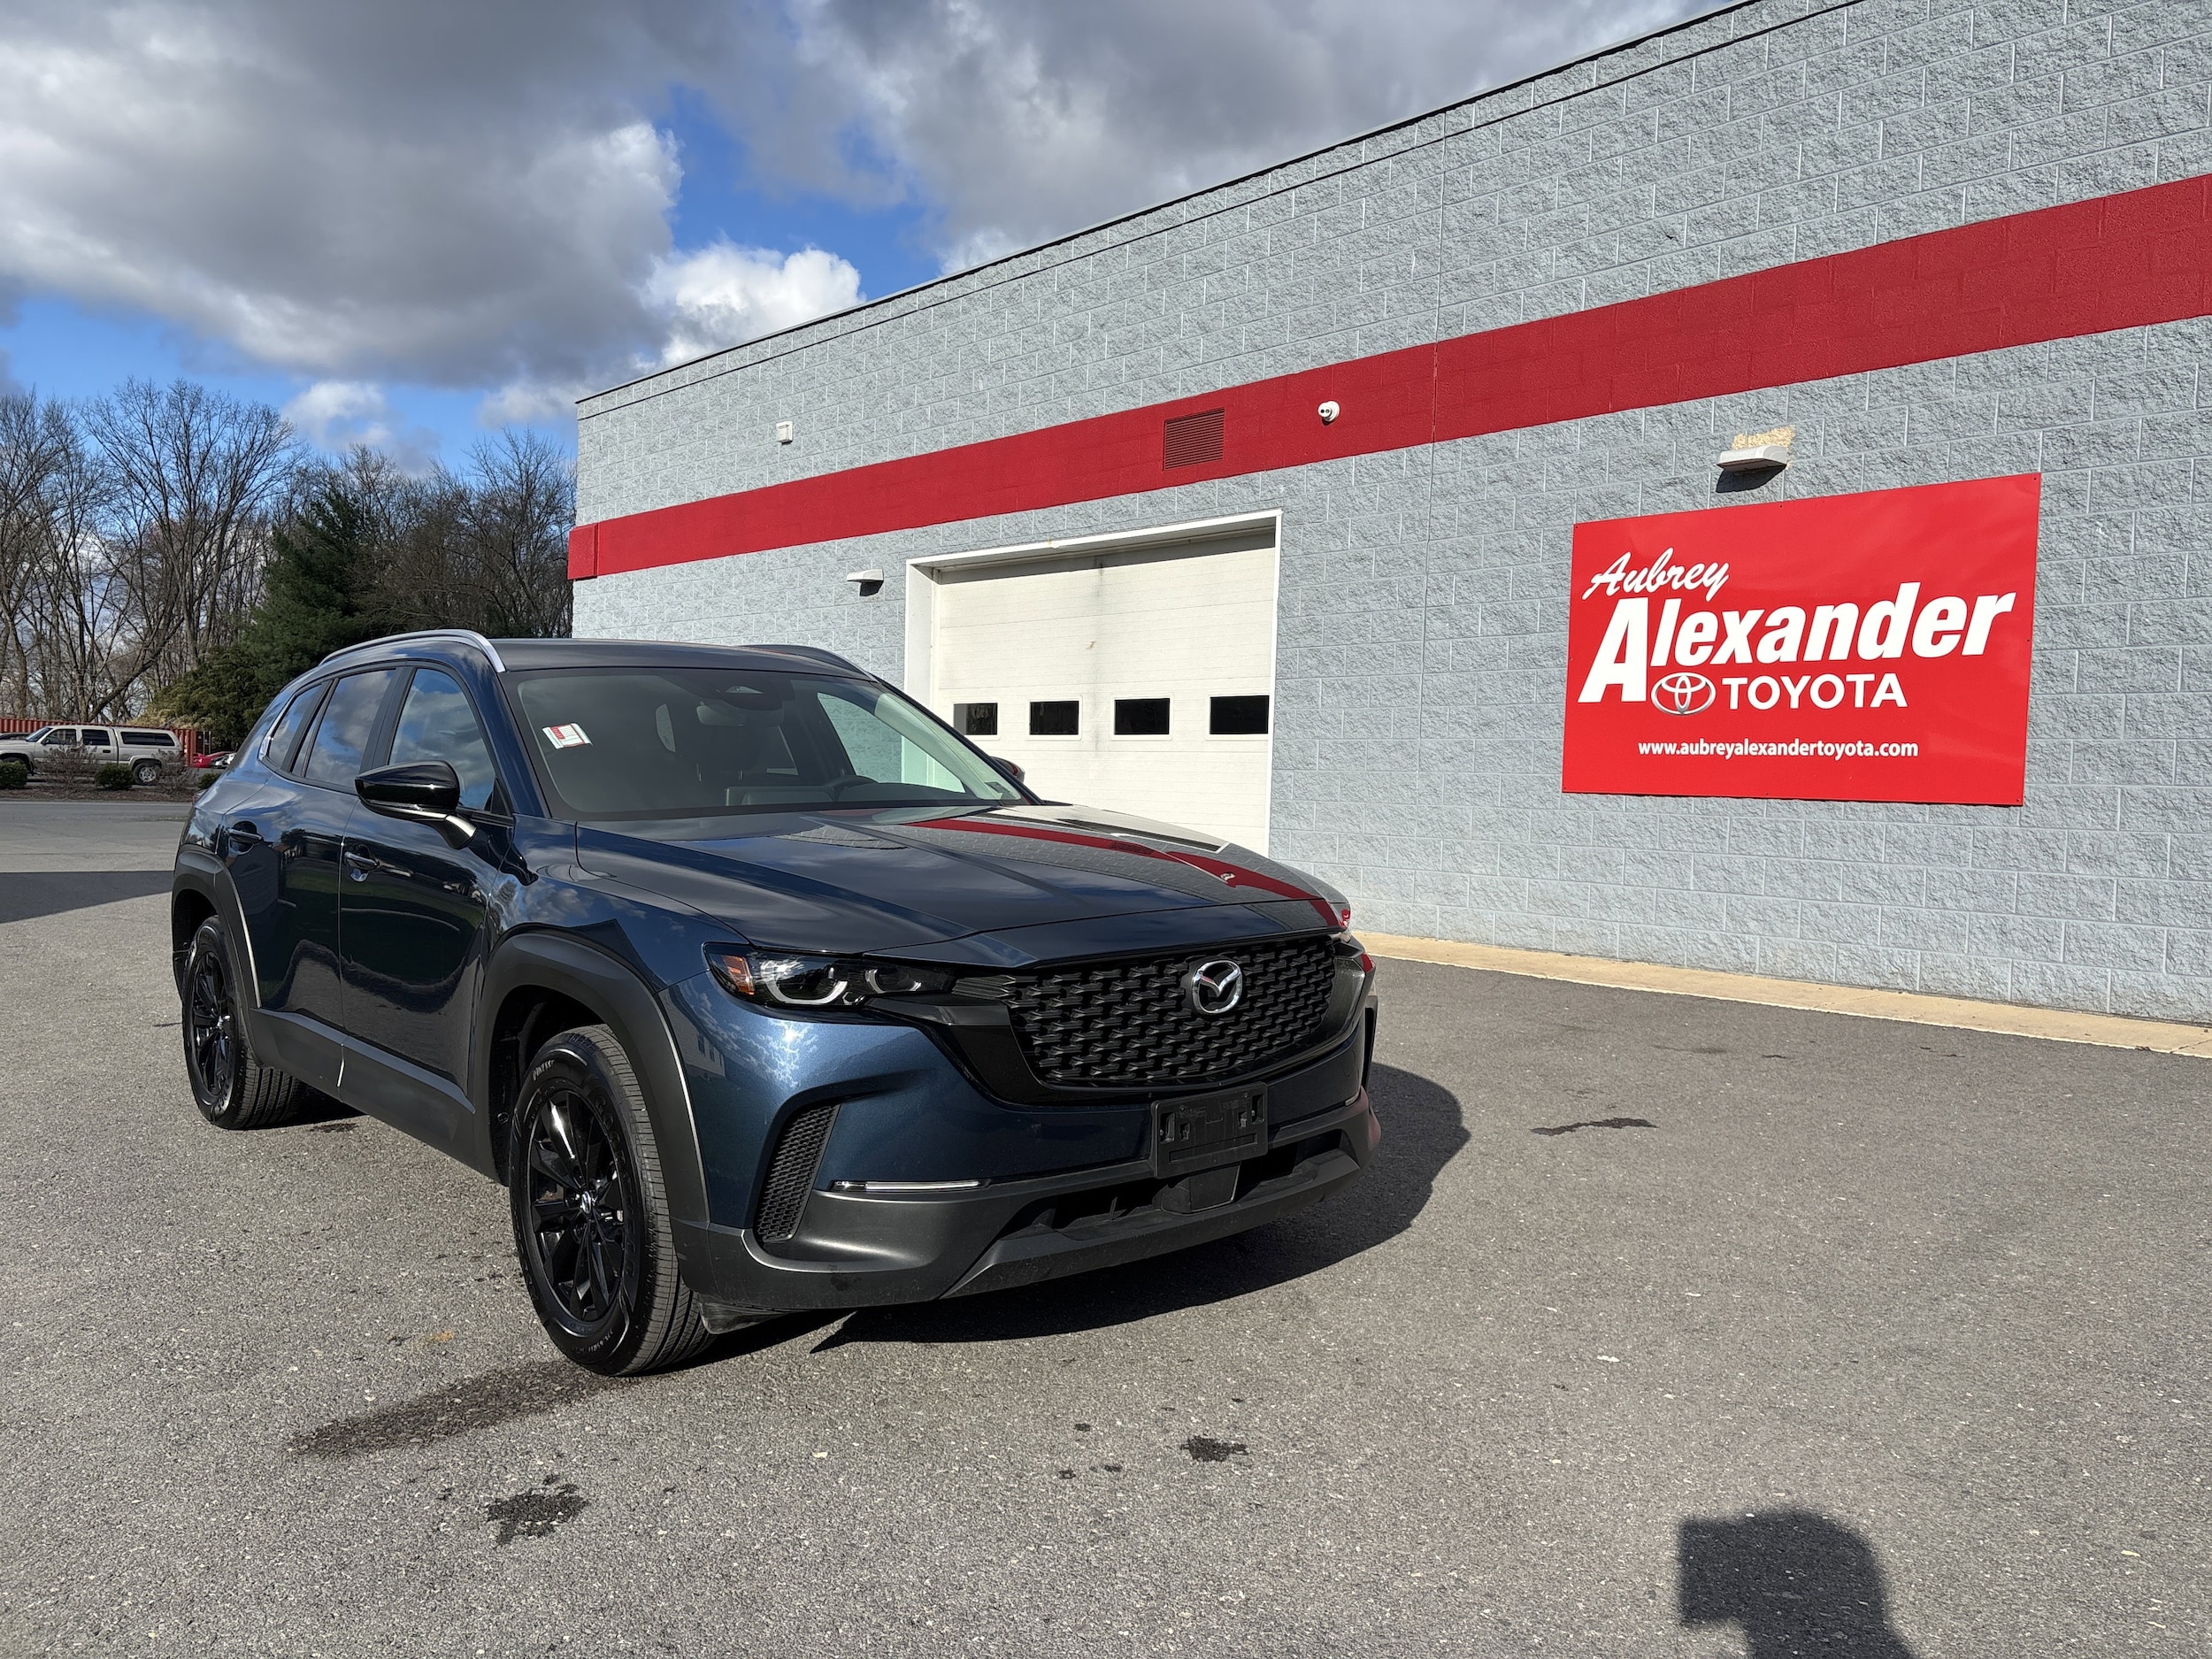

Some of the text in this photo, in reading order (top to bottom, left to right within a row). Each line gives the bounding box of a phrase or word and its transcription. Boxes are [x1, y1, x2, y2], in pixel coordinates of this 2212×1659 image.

[1582, 547, 1729, 602] Aubrey
[1577, 581, 2016, 703] Alexander
[1722, 672, 1908, 710] TOYOTA
[1638, 738, 1919, 761] www.aubreyalexandertoyota.com
